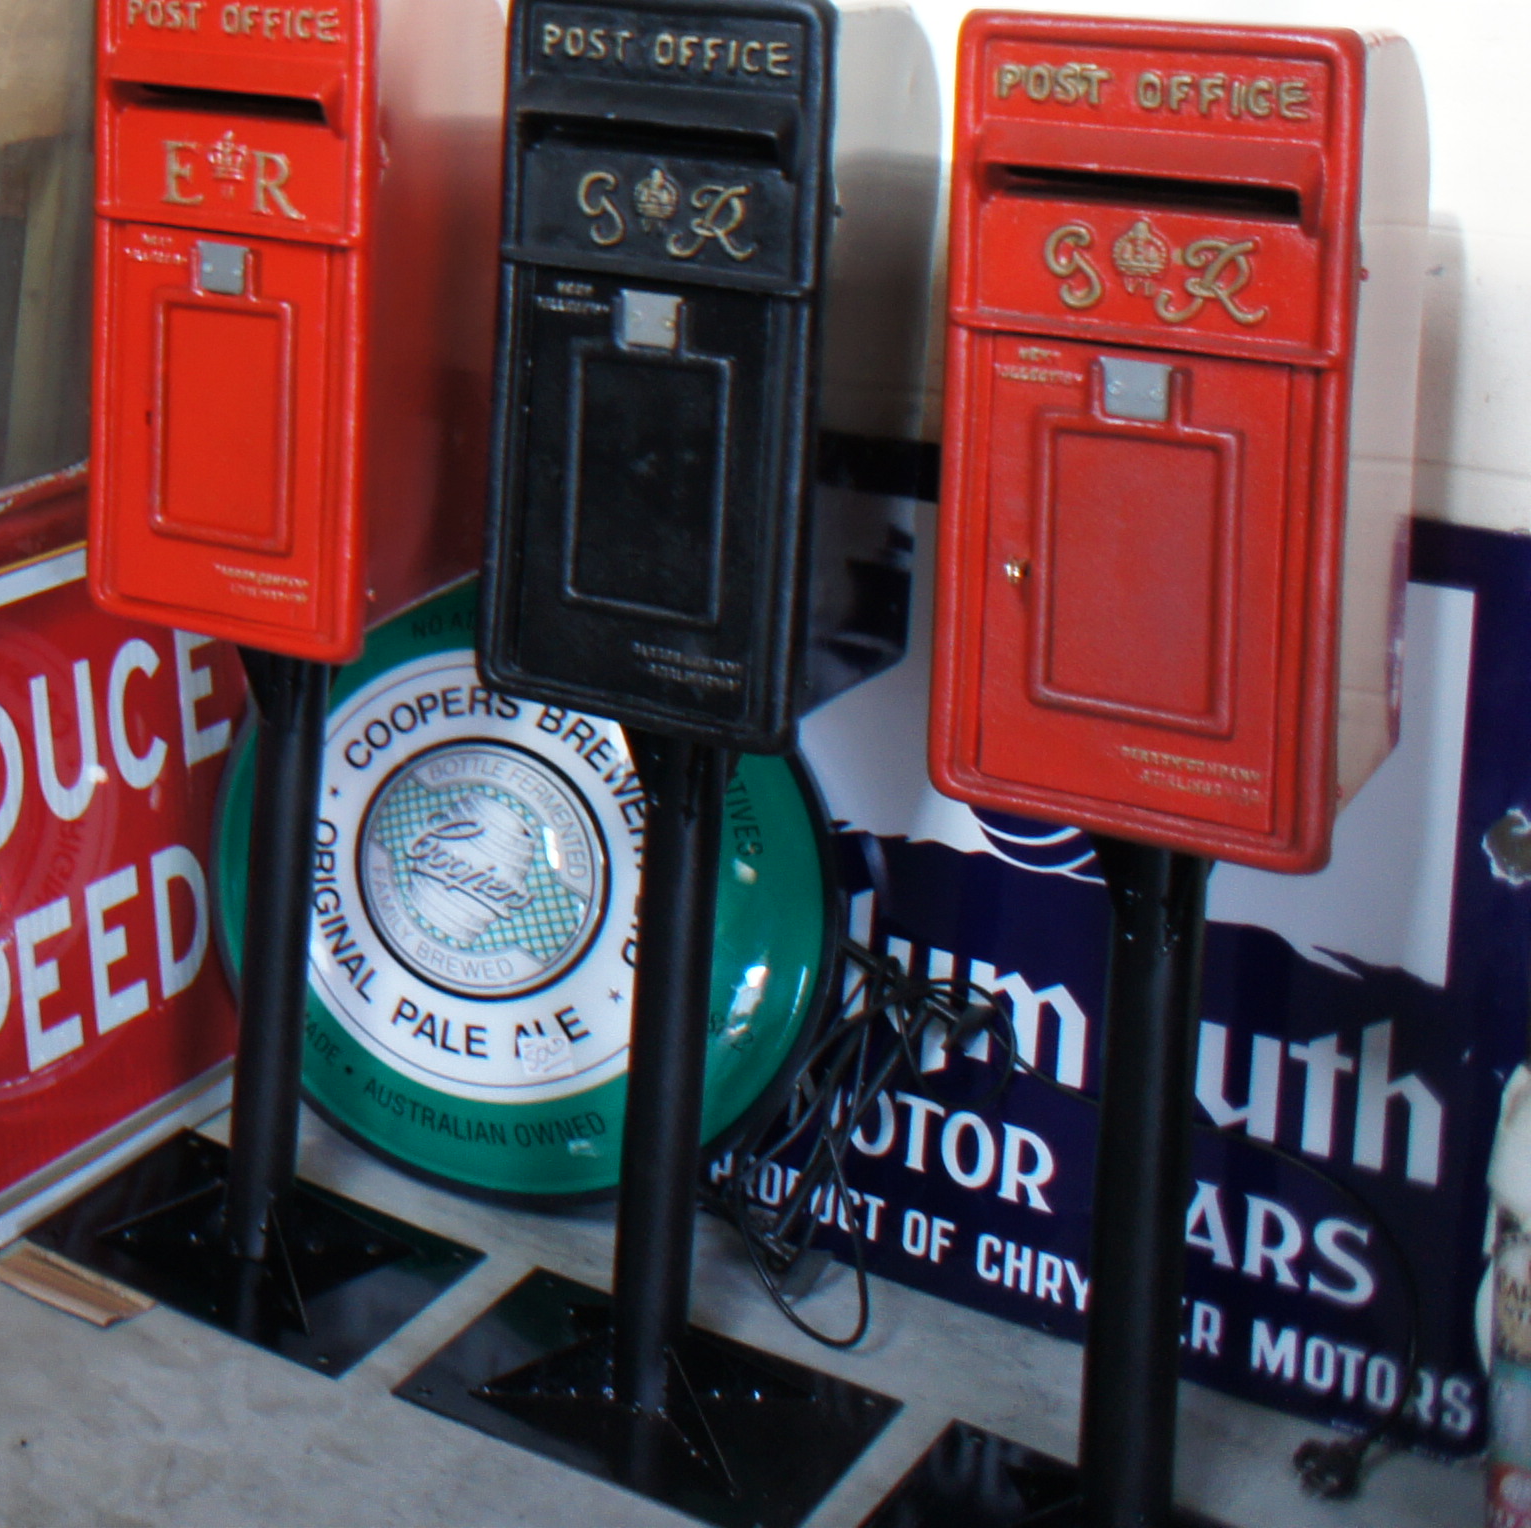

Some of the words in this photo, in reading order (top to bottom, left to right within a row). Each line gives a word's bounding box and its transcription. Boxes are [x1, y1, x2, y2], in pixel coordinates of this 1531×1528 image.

[221, 1, 342, 43] OFFICE
[542, 22, 634, 63] POST
[653, 31, 792, 77] OFFICE
[995, 62, 1112, 106] POST
[1136, 71, 1311, 121] OFFICE
[344, 684, 522, 770] COOPERS
[428, 755, 511, 780] BOTTLE
[312, 818, 379, 1004] ORIGINAL
[391, 996, 489, 1060] PALE
[371, 865, 415, 940] FAMILY
[415, 939, 515, 981] BREWED
[363, 1077, 506, 1147] AUSTRALIAN
[514, 1111, 607, 1148] OWNED
[902, 1208, 956, 1264] OF
[1186, 1180, 1376, 1308] ARS
